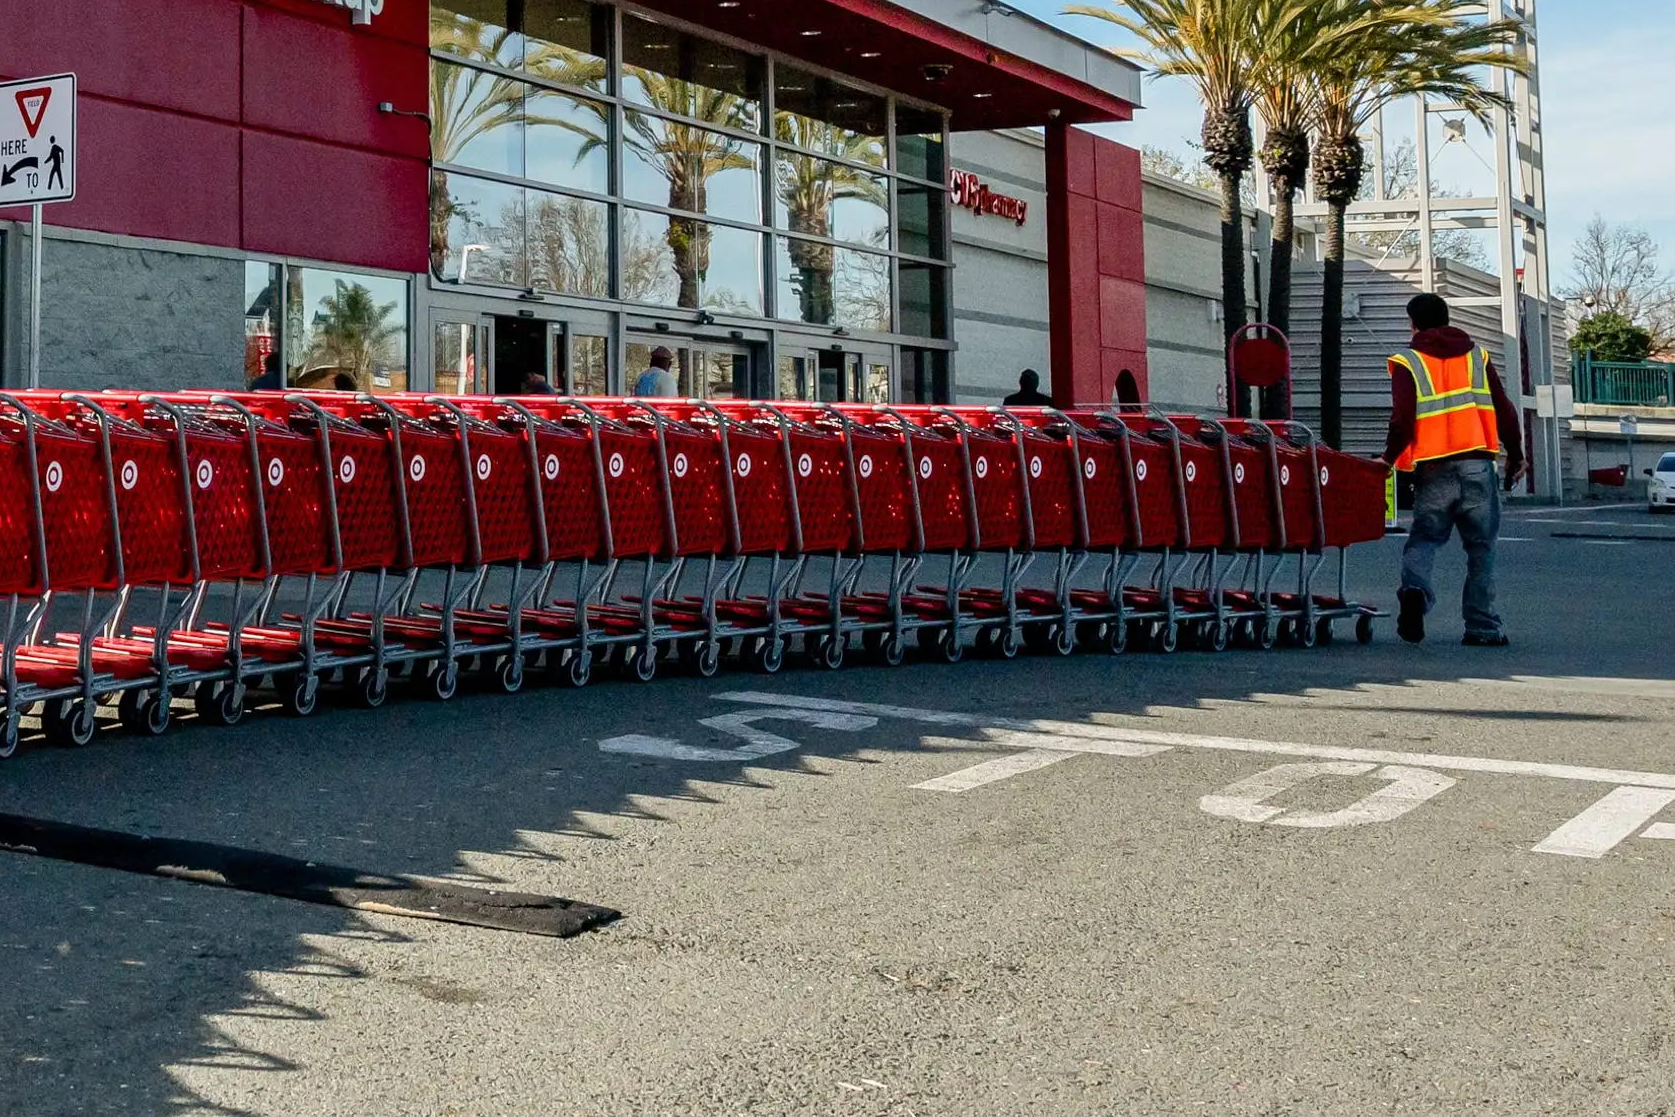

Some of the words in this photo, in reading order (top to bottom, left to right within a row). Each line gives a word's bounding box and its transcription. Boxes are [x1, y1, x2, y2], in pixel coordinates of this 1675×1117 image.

[1, 139, 28, 156] HERE
[26, 172, 39, 189] TO
[950, 169, 980, 209] CVS
